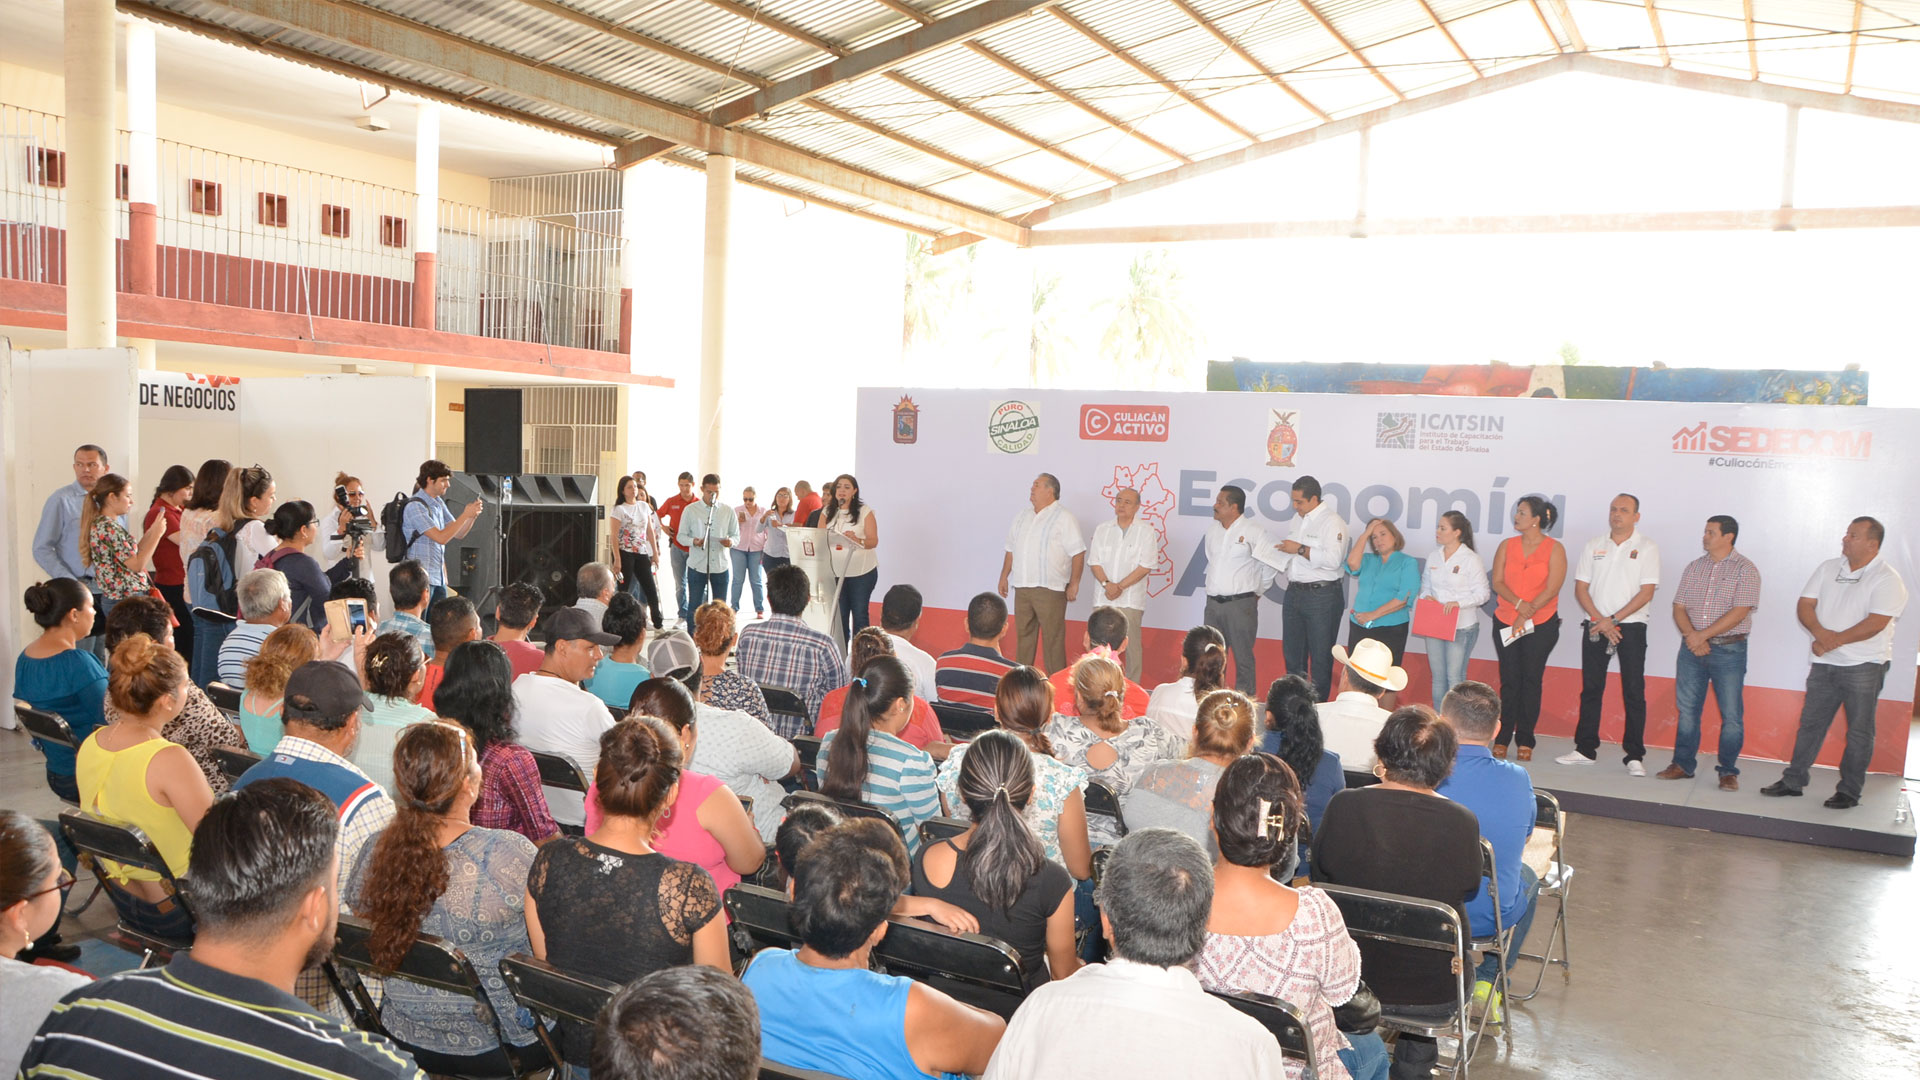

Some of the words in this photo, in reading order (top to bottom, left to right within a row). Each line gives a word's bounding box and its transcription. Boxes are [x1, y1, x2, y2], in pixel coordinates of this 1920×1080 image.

[139, 383, 159, 406] DE
[164, 385, 236, 411] NEGOCIOS
[999, 404, 1024, 415] PURO
[1114, 411, 1166, 422] CULIACÁN
[1421, 413, 1504, 432] ICATSIN
[990, 417, 1037, 436] SINALOA
[1113, 423, 1166, 435] ACTIVO
[998, 433, 1033, 450] CALIDAD
[1445, 438, 1470, 447] Trabajo
[1460, 433, 1503, 441] Capacitación
[1708, 425, 1873, 458] SEDECOM
[1432, 444, 1453, 452] Estado
